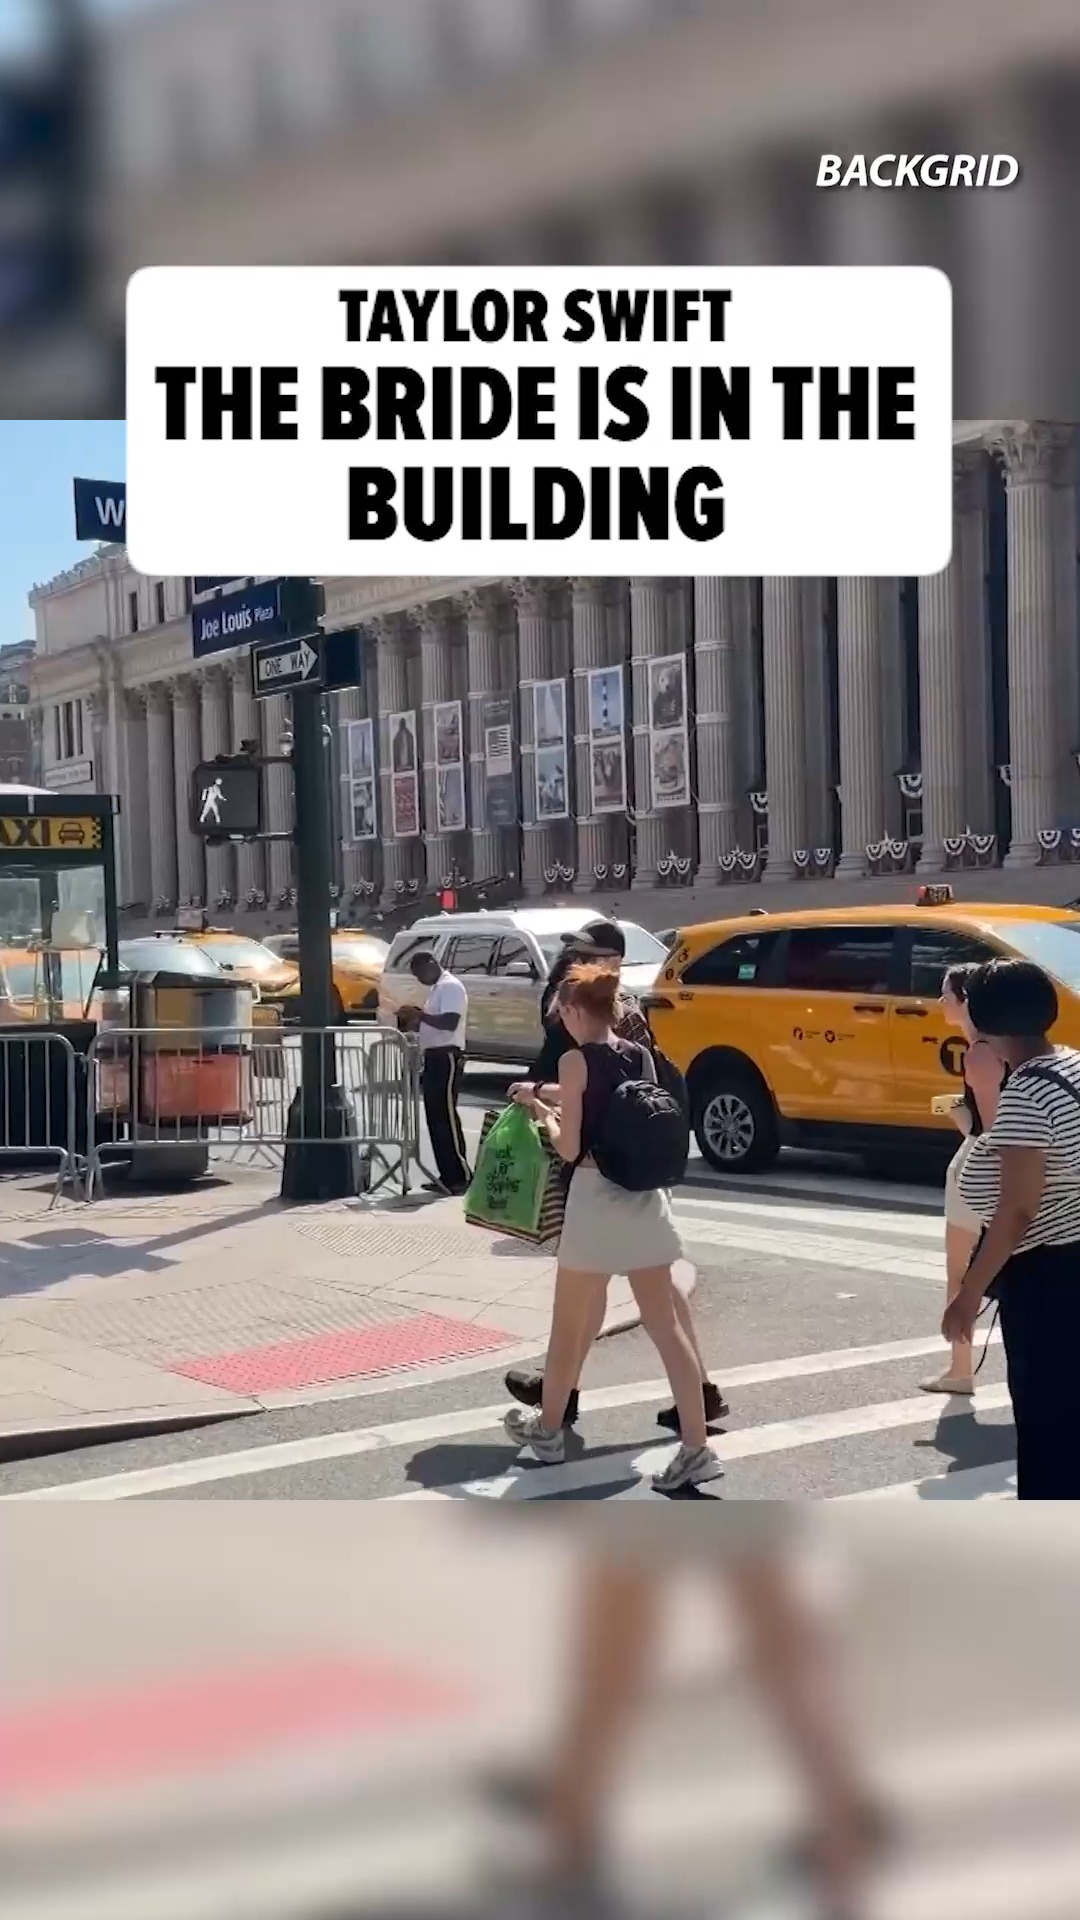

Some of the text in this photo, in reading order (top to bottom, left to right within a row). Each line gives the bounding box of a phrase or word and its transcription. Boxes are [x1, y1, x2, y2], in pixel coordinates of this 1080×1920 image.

[201, 603, 275, 641] Joe Louis Plaza
[265, 651, 311, 677] ONE WAY
